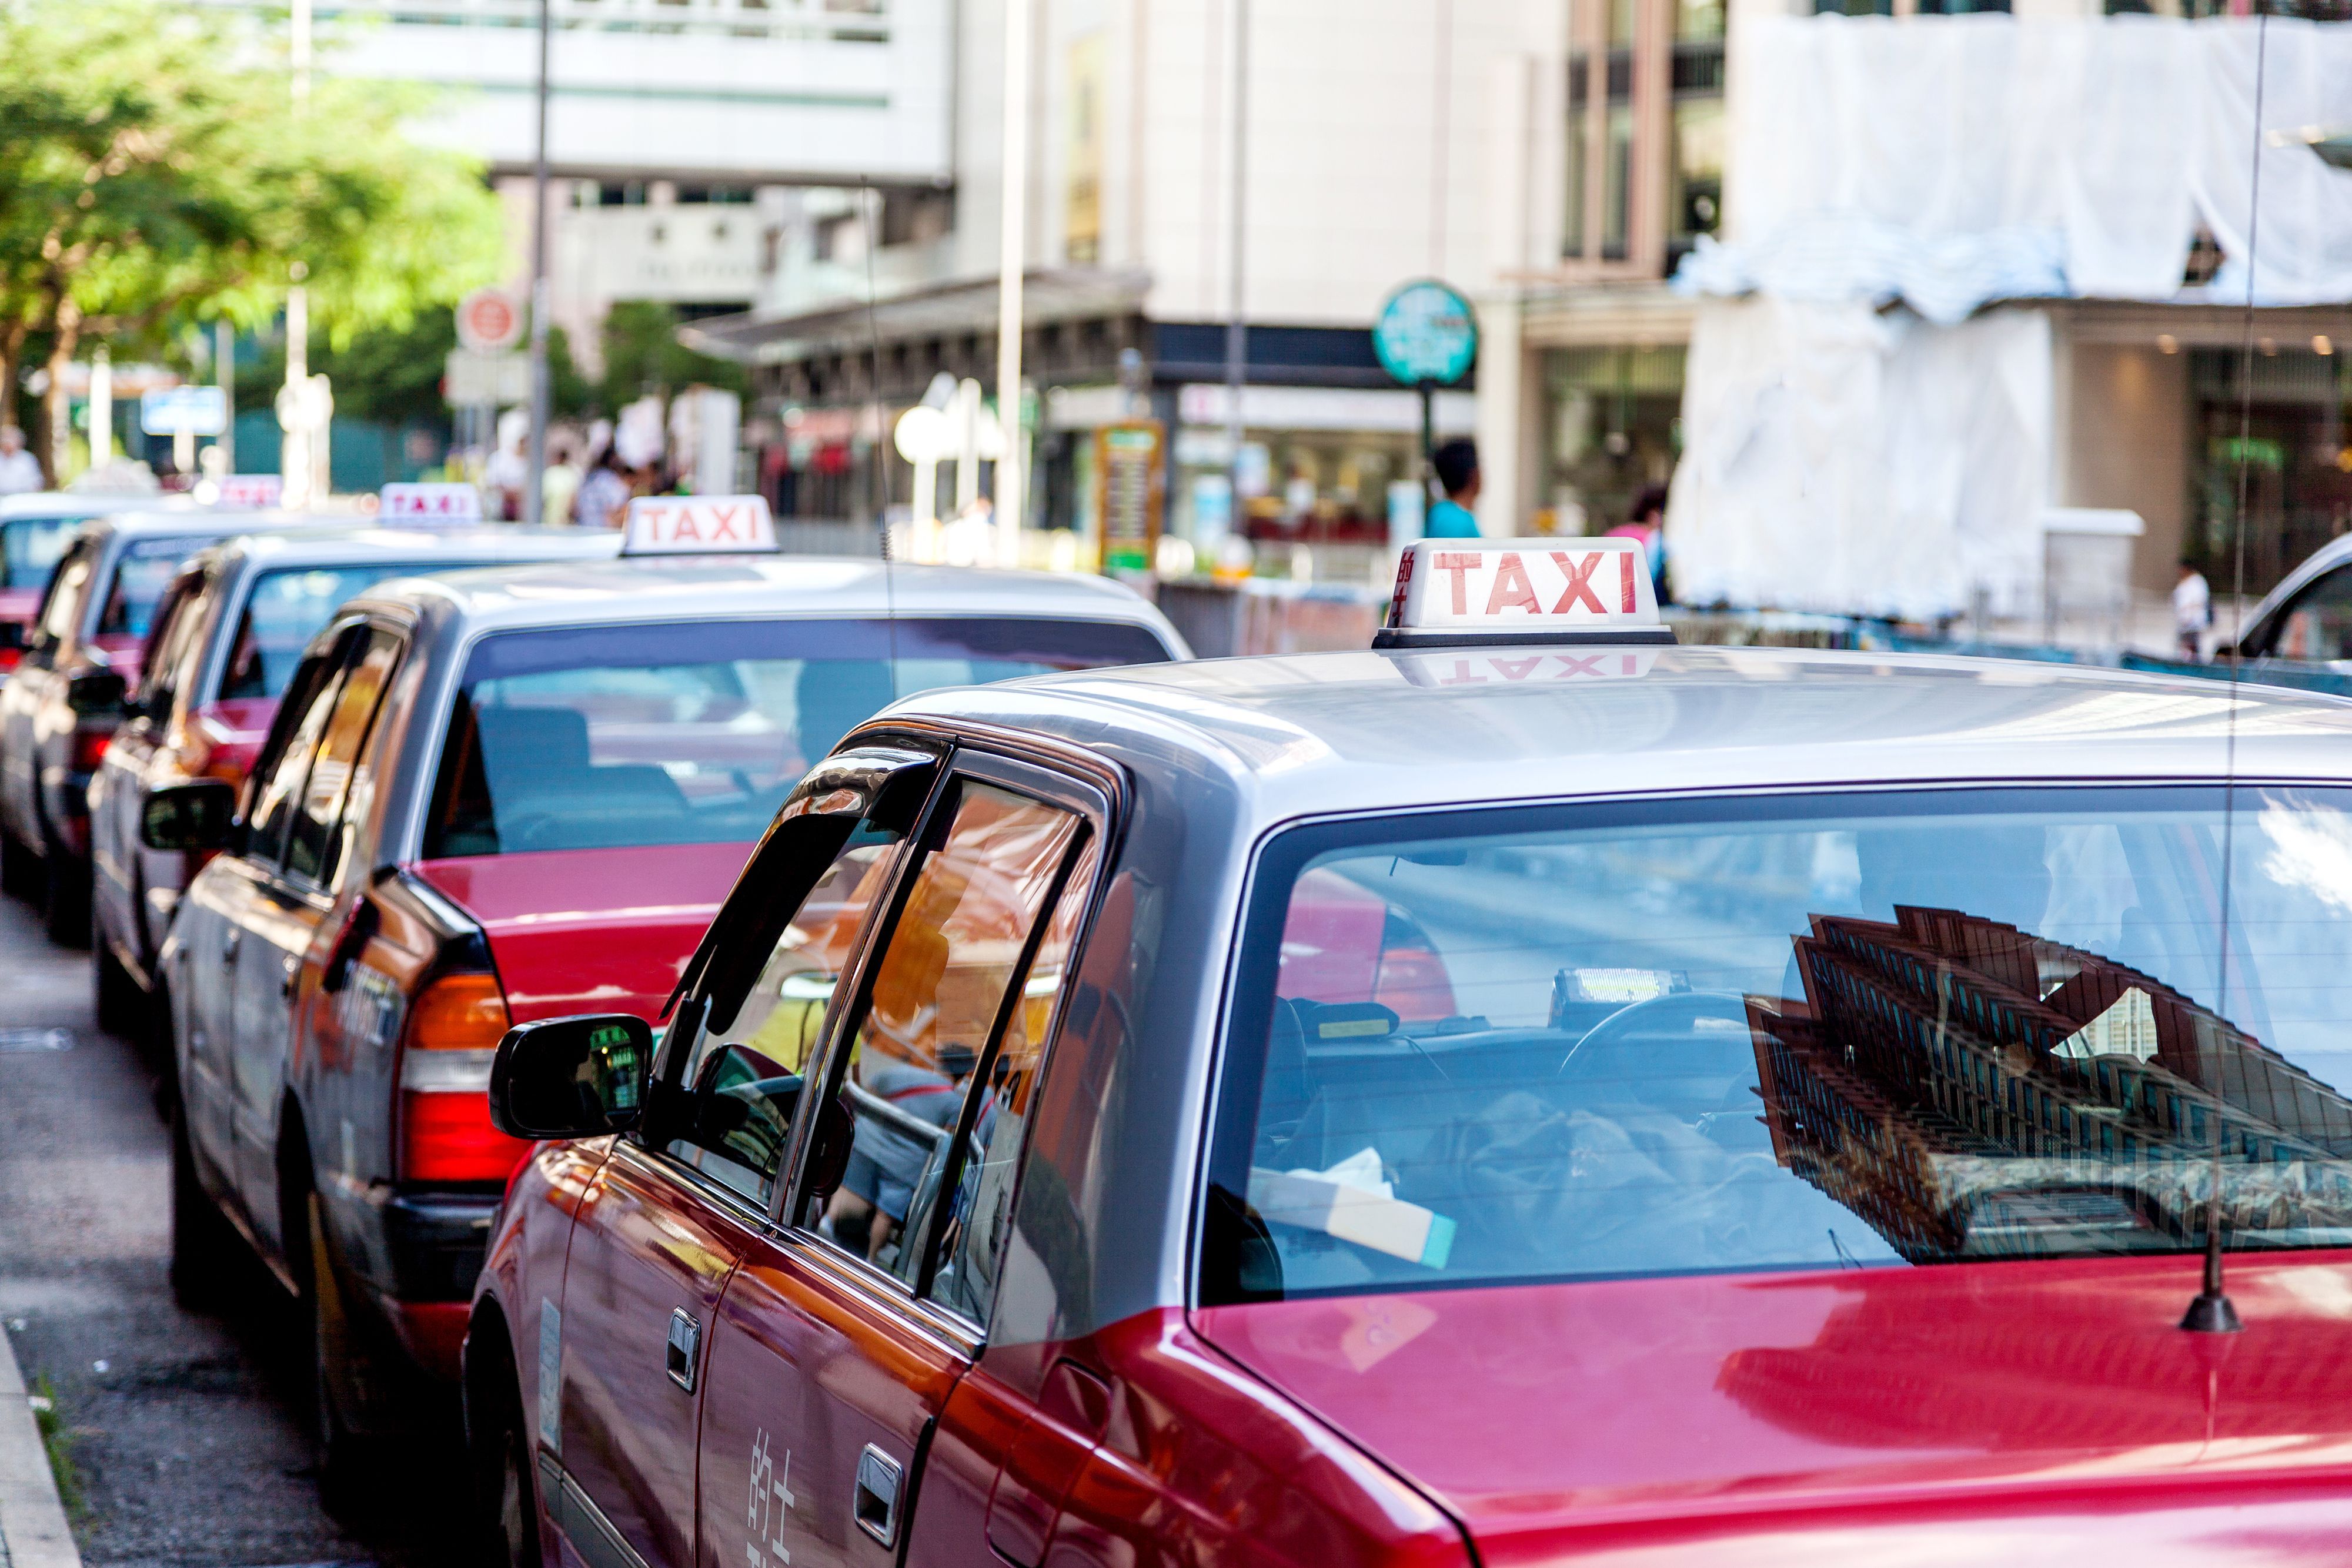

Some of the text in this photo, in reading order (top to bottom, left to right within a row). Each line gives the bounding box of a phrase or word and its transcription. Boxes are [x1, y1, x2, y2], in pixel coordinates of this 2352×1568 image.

[642, 505, 757, 541] TAXI
[1392, 551, 1415, 617] 的士
[1434, 551, 1636, 615] TAXI
[748, 1427, 795, 1566] 的士
